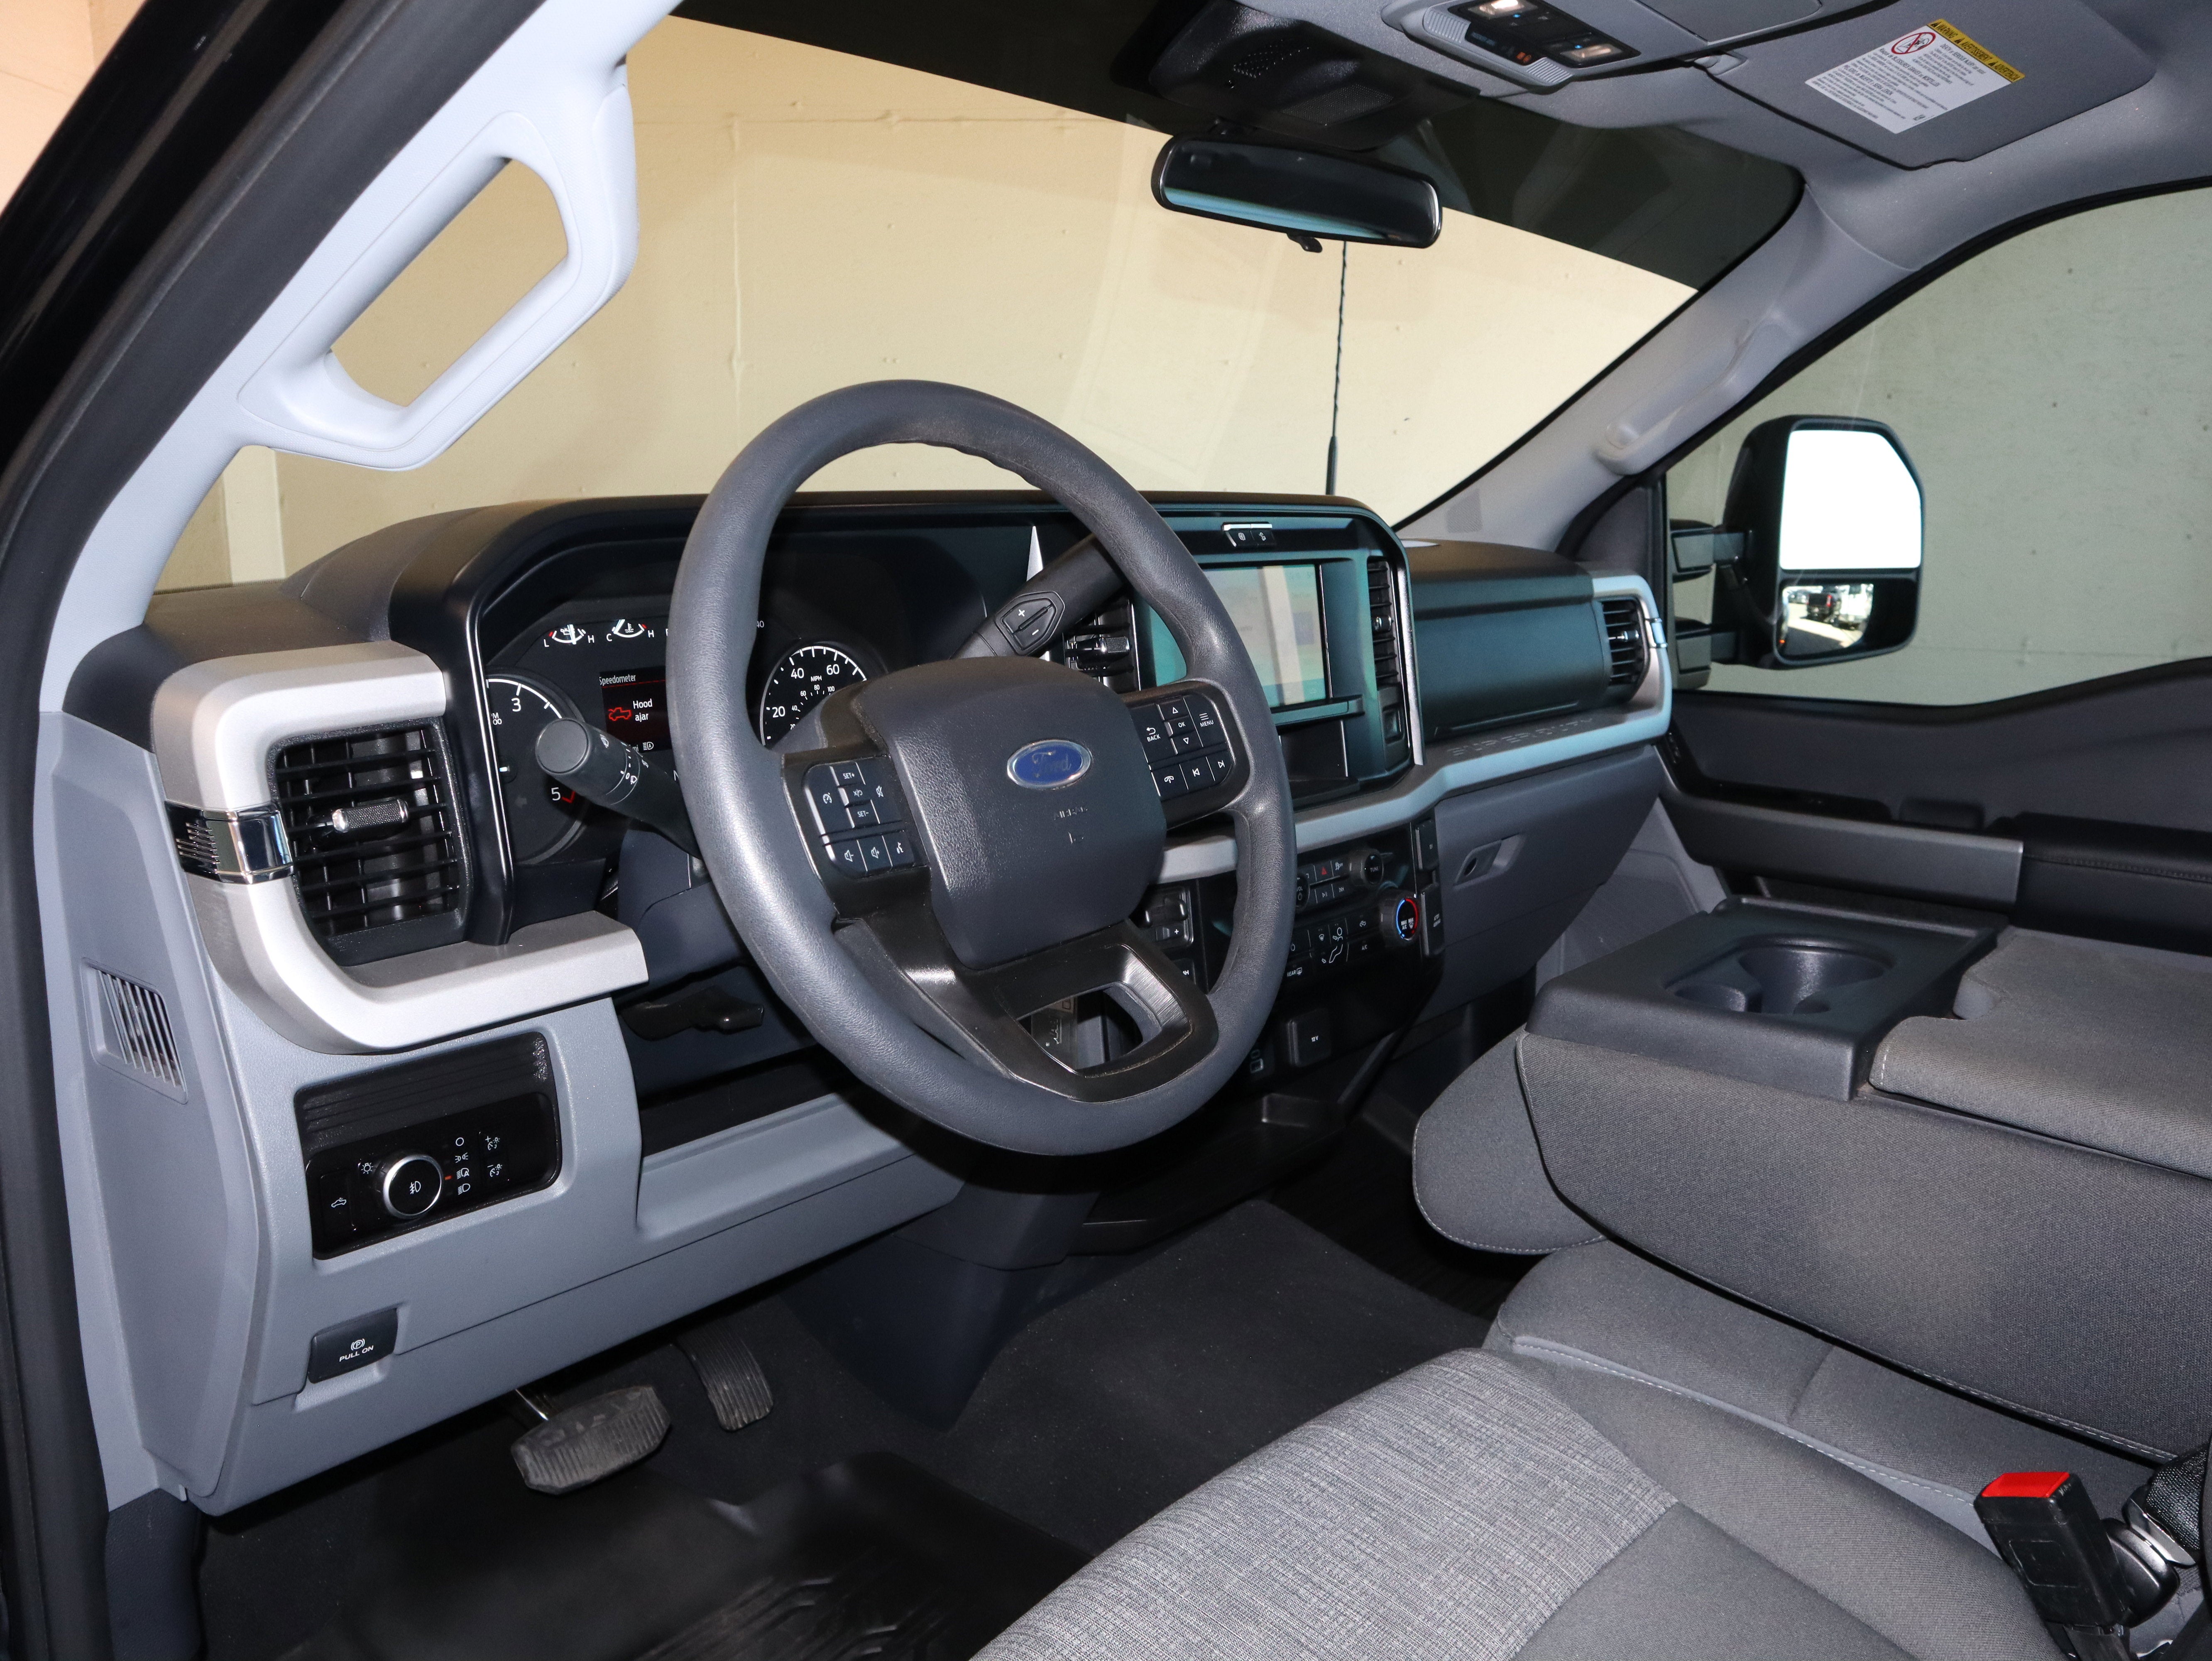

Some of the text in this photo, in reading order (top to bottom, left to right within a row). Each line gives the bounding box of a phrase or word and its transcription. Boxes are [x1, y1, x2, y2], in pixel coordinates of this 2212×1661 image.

[1936, 24, 1958, 38] WARNING
[606, 634, 613, 642] C
[648, 630, 654, 638] H
[544, 639, 549, 647] L
[791, 668, 804, 679] 40
[826, 664, 839, 675] 60
[599, 674, 636, 686] Speedometer
[511, 698, 521, 712] 3
[633, 698, 653, 709] Hood
[635, 712, 649, 723] ajar
[772, 706, 785, 718] 20
[1147, 734, 1161, 742] BACK
[551, 787, 561, 801] 5
[339, 1345, 374, 1362] PULL ON
